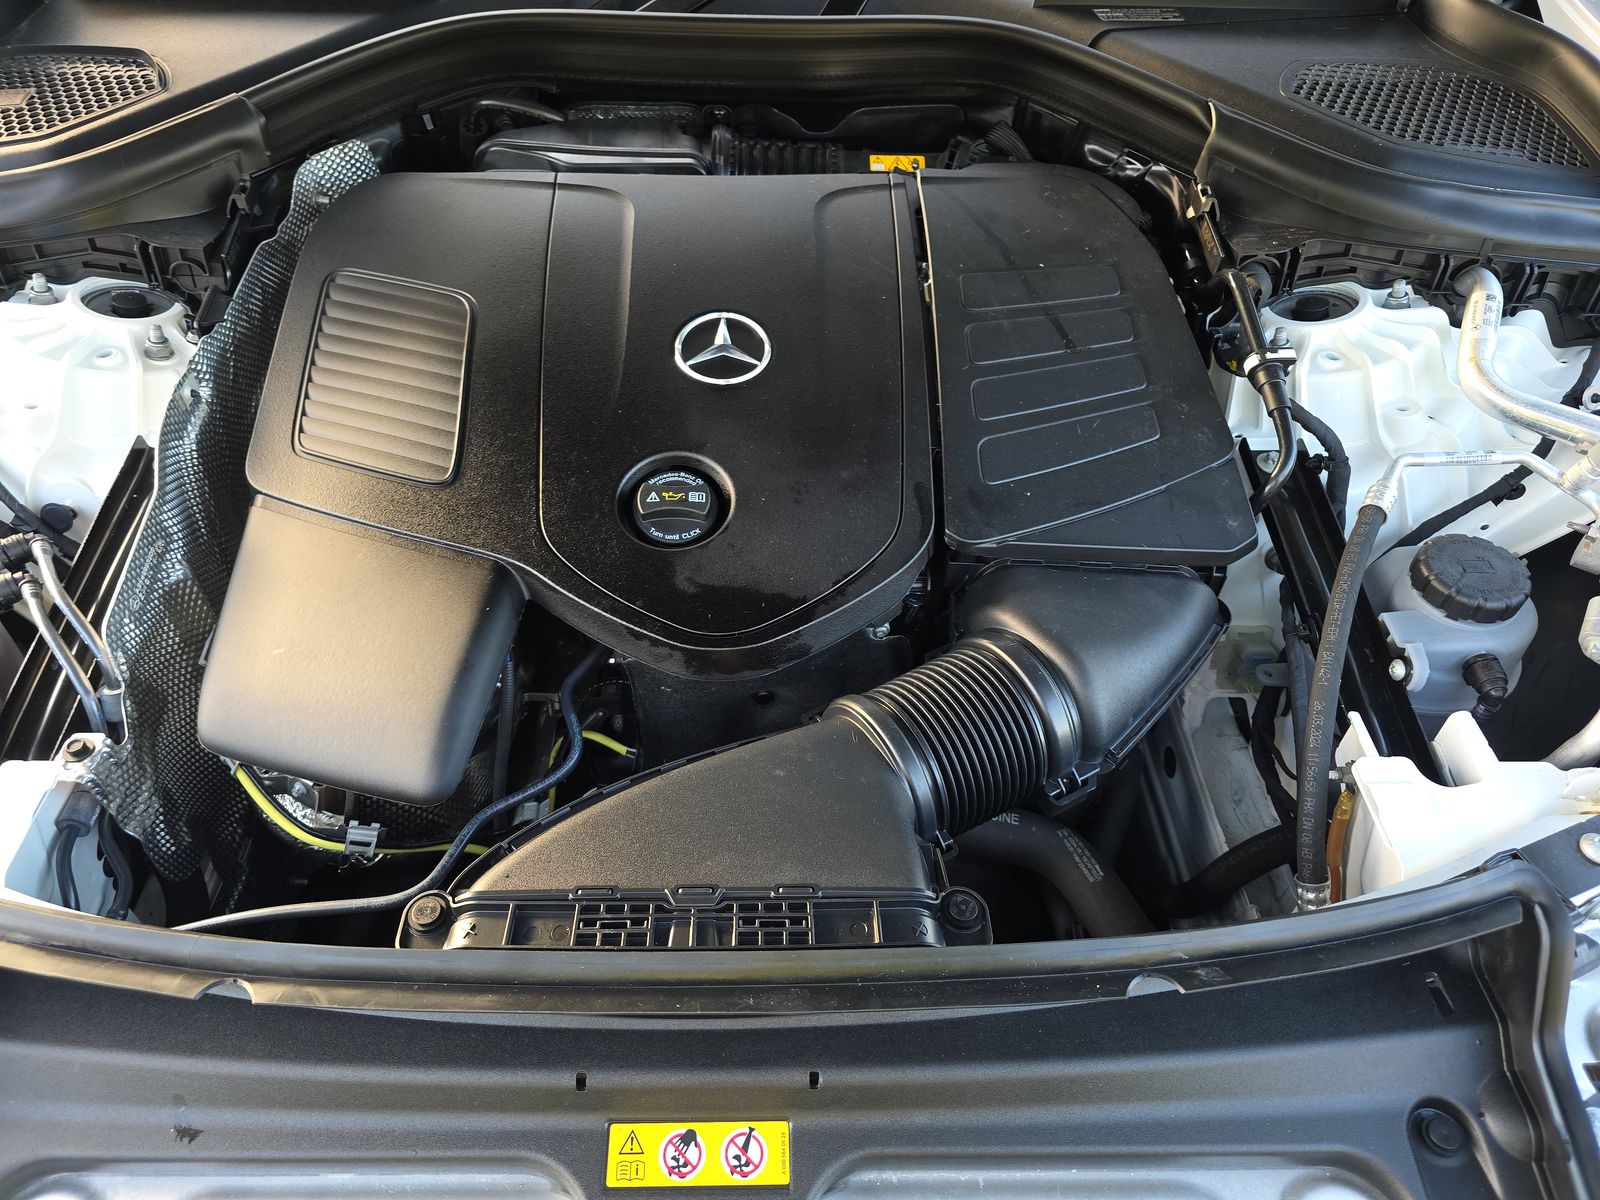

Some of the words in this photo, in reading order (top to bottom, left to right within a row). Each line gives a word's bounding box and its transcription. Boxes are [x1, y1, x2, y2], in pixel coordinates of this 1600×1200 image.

[648, 472, 696, 485] Mercedes-Benz
[656, 477, 696, 485] recommended
[649, 527, 664, 538] Turn
[681, 527, 702, 539] CLICK
[1309, 700, 1326, 748] 26.03.2024
[1304, 752, 1320, 793] 11:56:58
[991, 812, 1020, 825] INE
